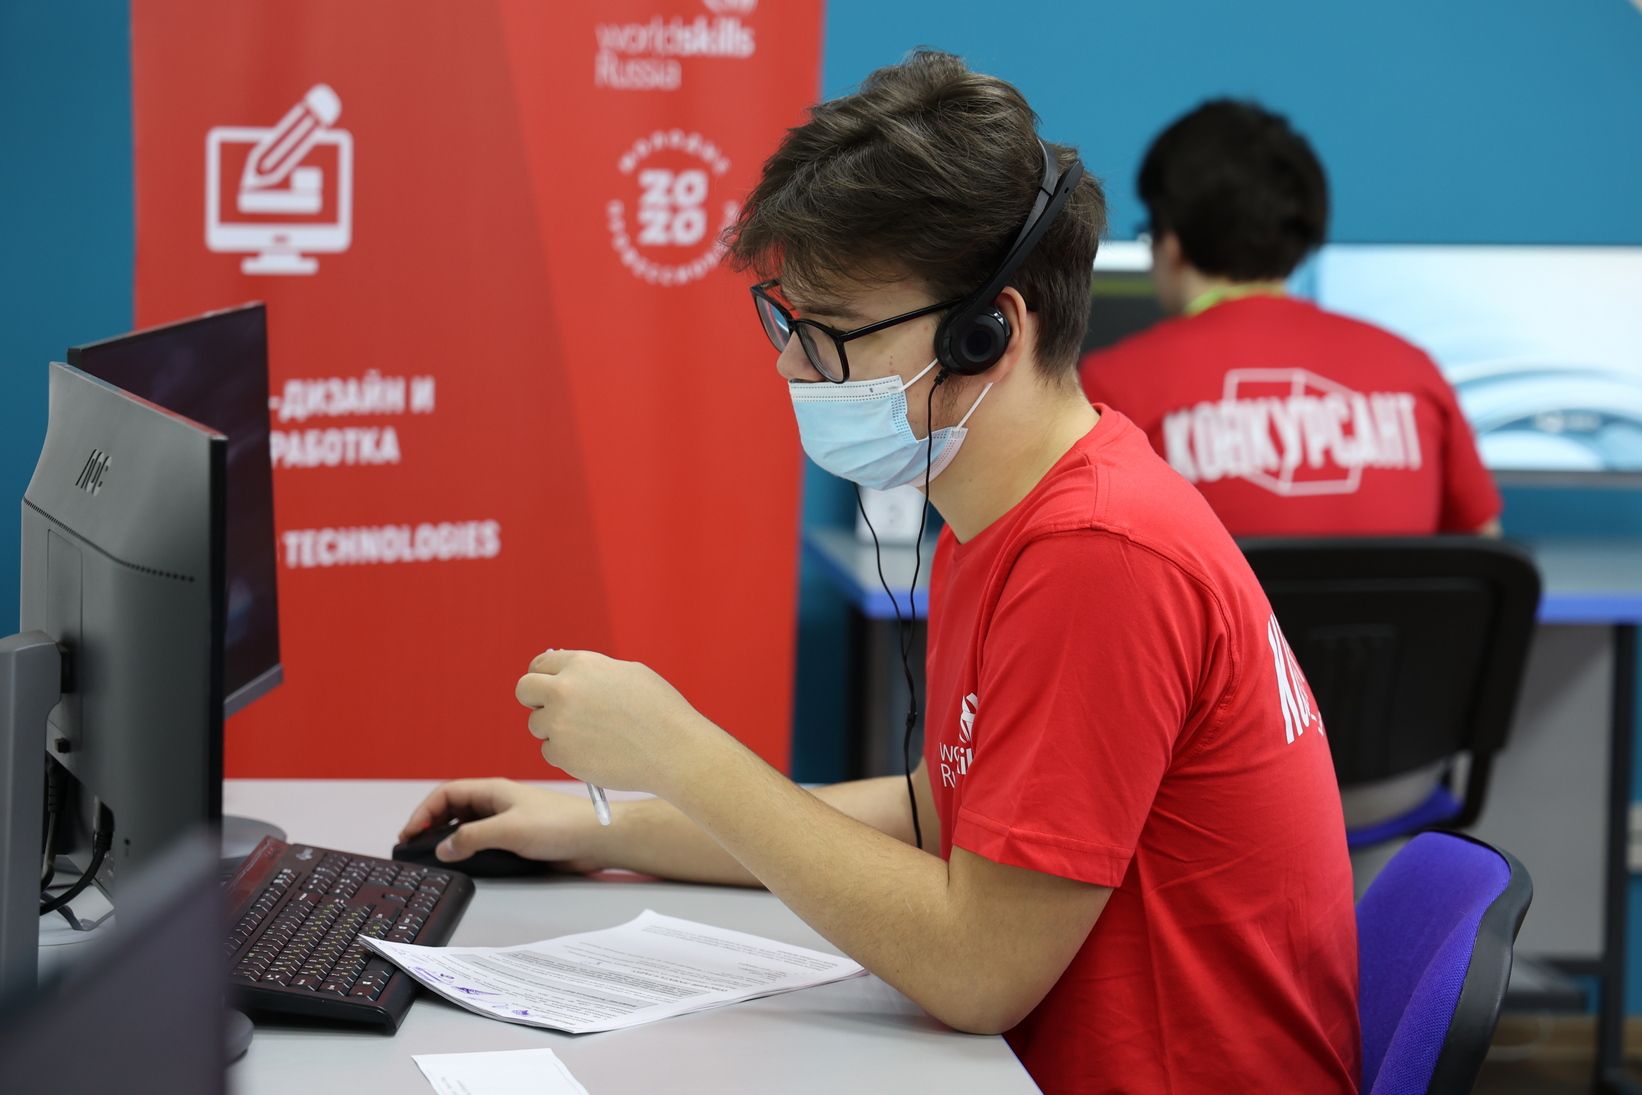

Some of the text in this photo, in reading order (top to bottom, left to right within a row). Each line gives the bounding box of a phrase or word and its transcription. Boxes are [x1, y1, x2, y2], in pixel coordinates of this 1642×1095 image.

[595, 15, 756, 58] worldskills
[594, 49, 682, 90] Russia
[410, 375, 435, 413] И
[1163, 391, 1421, 483] КОНКУРСАНТ
[282, 519, 501, 568] TECHNOLOGIES
